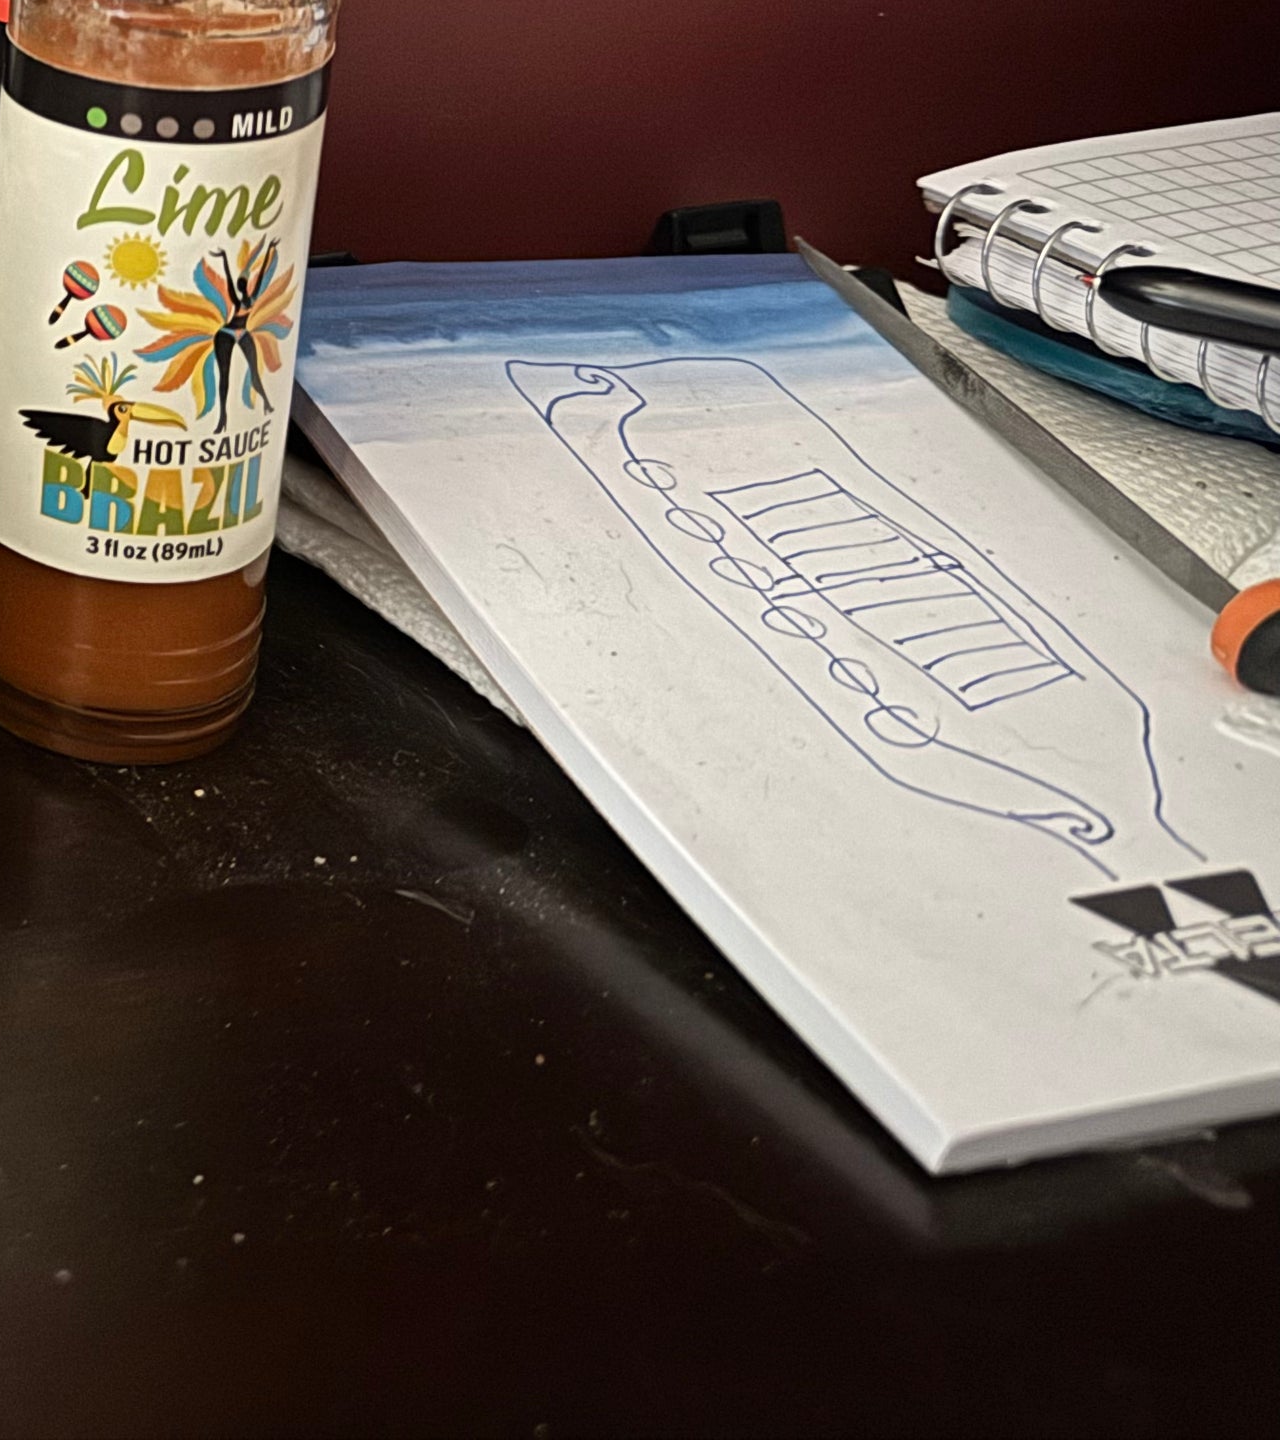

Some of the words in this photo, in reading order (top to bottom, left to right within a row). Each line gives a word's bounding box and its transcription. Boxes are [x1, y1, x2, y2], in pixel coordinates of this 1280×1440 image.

[231, 106, 293, 138] MILD
[76, 148, 284, 238] Lime
[133, 439, 193, 465] HOT
[198, 420, 272, 464] SAUCE
[40, 447, 264, 536] BRAZIL
[86, 536, 100, 555] 3
[104, 539, 119, 558] fl
[123, 546, 148, 560] oz
[151, 536, 224, 563] (89mL)
